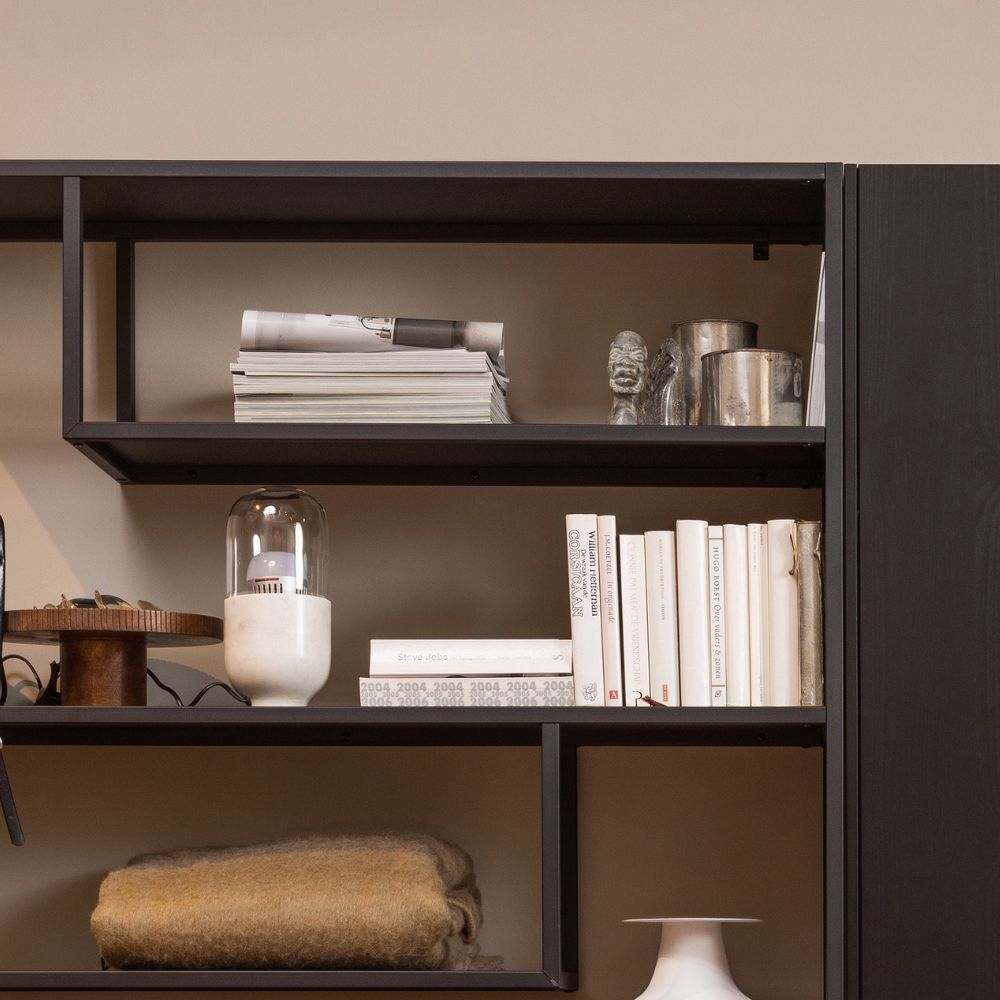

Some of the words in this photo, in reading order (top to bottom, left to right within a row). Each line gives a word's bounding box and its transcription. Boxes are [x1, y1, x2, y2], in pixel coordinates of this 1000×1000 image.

[581, 549, 587, 557] De
[588, 530, 597, 567] William
[712, 546, 720, 572] HUGO
[568, 529, 584, 618] CORSICAAN
[589, 569, 599, 617] Heffernan
[714, 604, 722, 622] Over
[714, 624, 723, 648] vaders
[397, 653, 423, 661] Steve
[425, 653, 448, 661] Jobs
[361, 681, 390, 691] 2004
[397, 681, 427, 691] 2004
[434, 681, 463, 691] 2004
[470, 681, 500, 691] 2004
[507, 681, 536, 691] 2004
